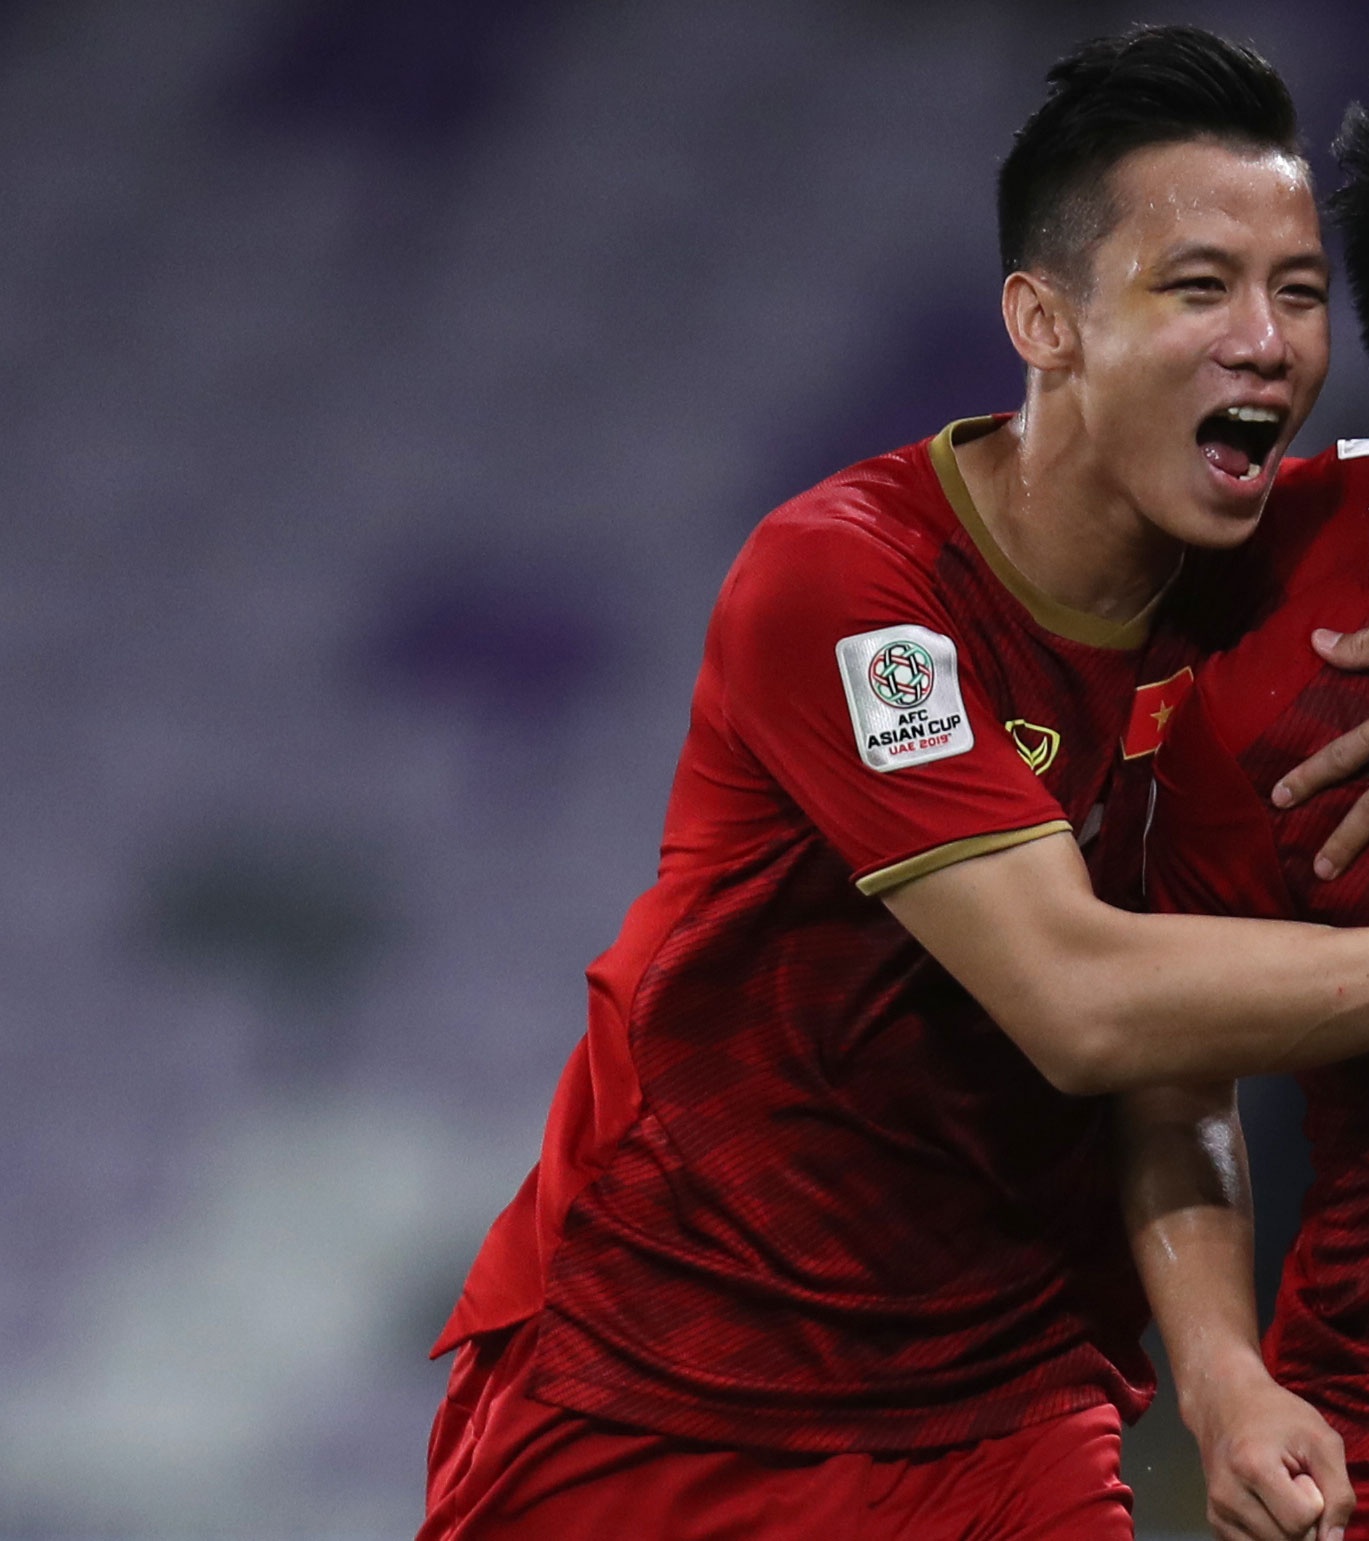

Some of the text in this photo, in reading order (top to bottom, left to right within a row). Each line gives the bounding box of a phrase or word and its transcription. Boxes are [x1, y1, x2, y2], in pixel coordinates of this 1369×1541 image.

[898, 709, 928, 726] AFC
[867, 714, 961, 749] ASIAN CUP
[889, 735, 949, 755] UAE 2019
